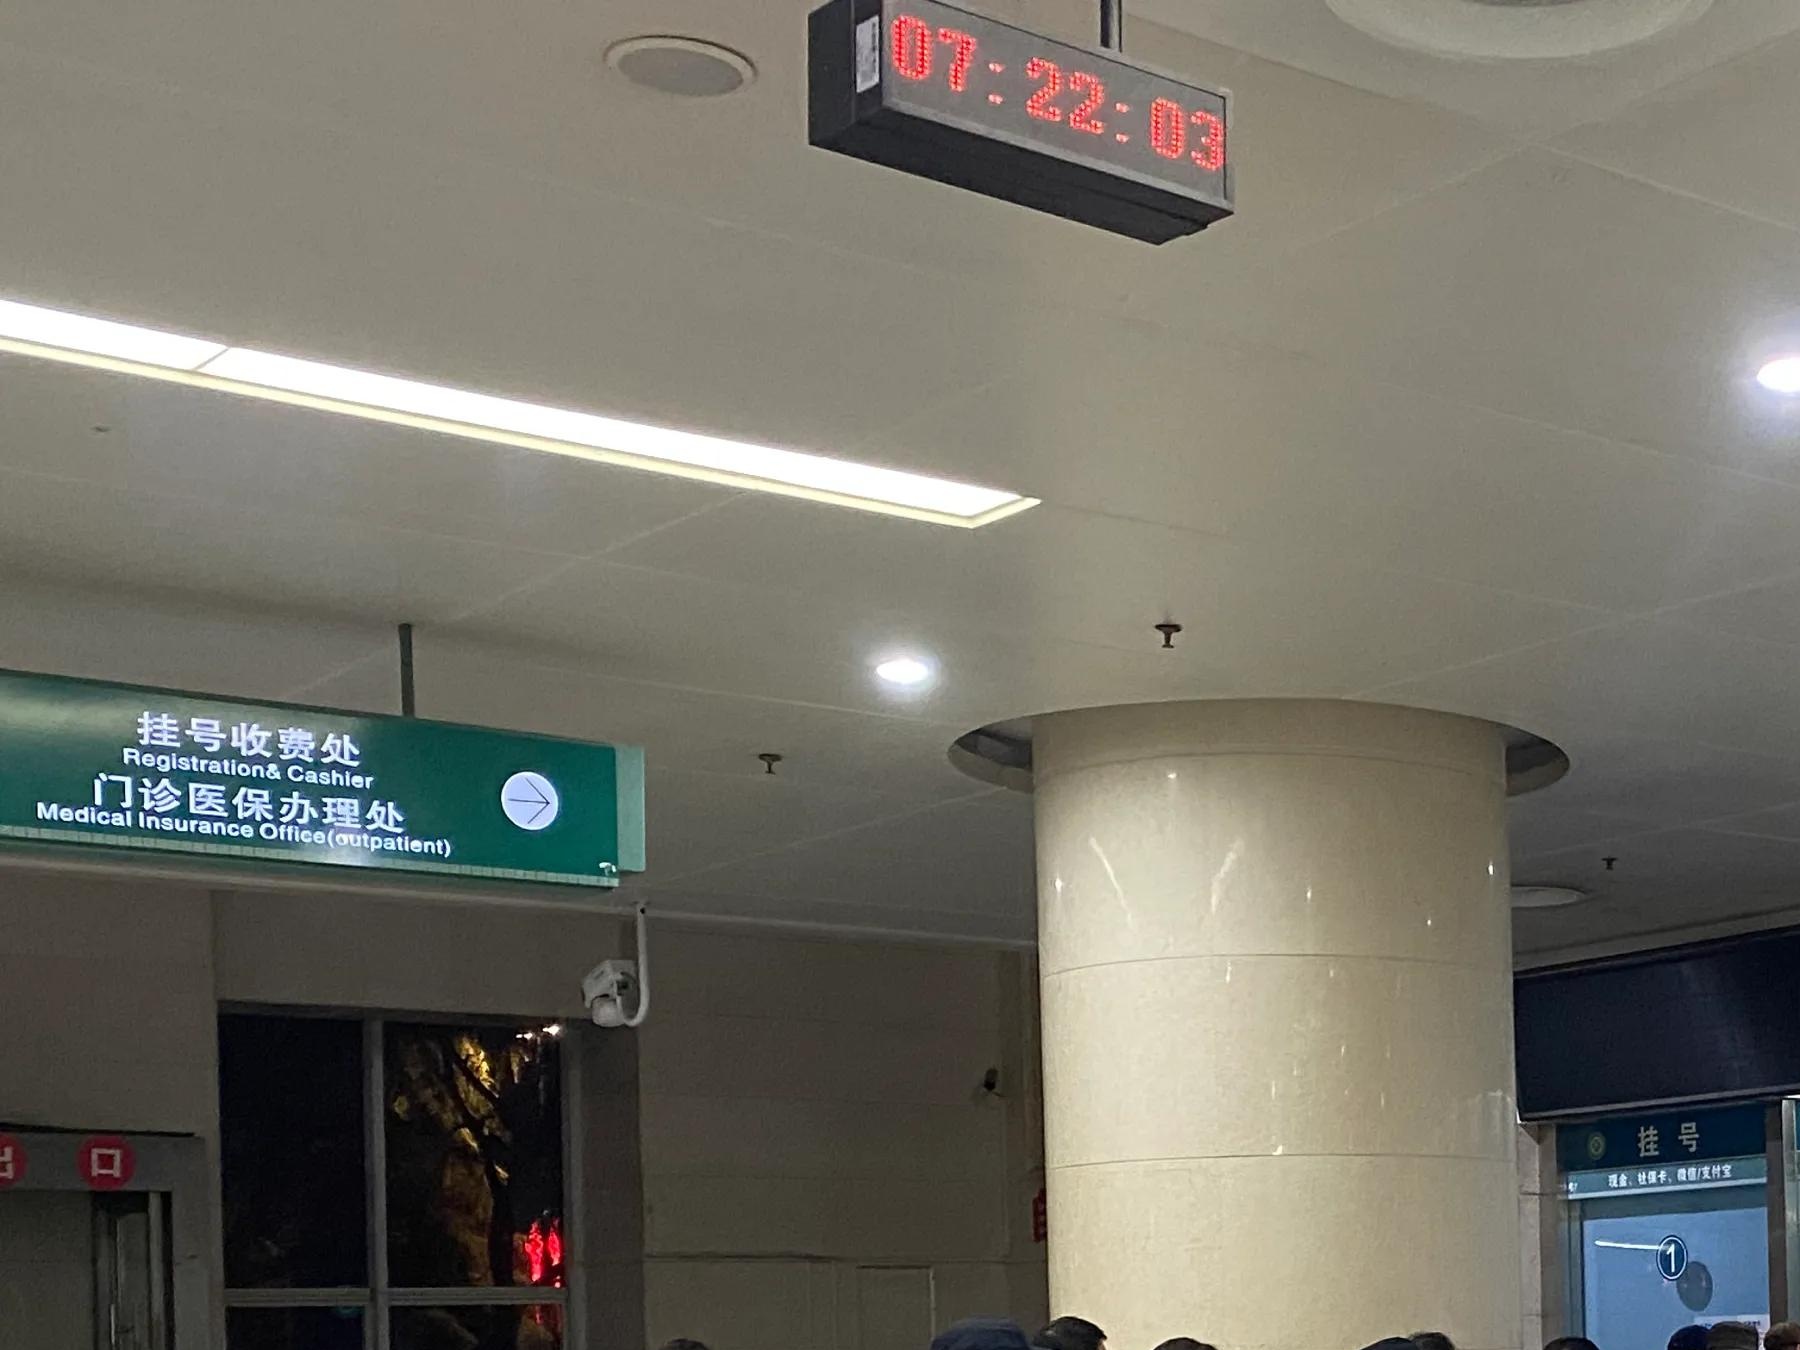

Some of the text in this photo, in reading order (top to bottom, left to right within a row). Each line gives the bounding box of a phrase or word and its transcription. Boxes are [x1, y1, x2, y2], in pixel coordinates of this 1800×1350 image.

[891, 15, 1225, 171] 07:22:03
[137, 711, 361, 767] 挂号收费处
[123, 748, 374, 790] Registration& Cashier
[37, 802, 132, 828] Medical
[138, 811, 253, 840] Insurance
[93, 772, 405, 834] 门诊医保办理处
[1638, 1122, 1700, 1157] 挂号
[1665, 1242, 1676, 1274] 1
